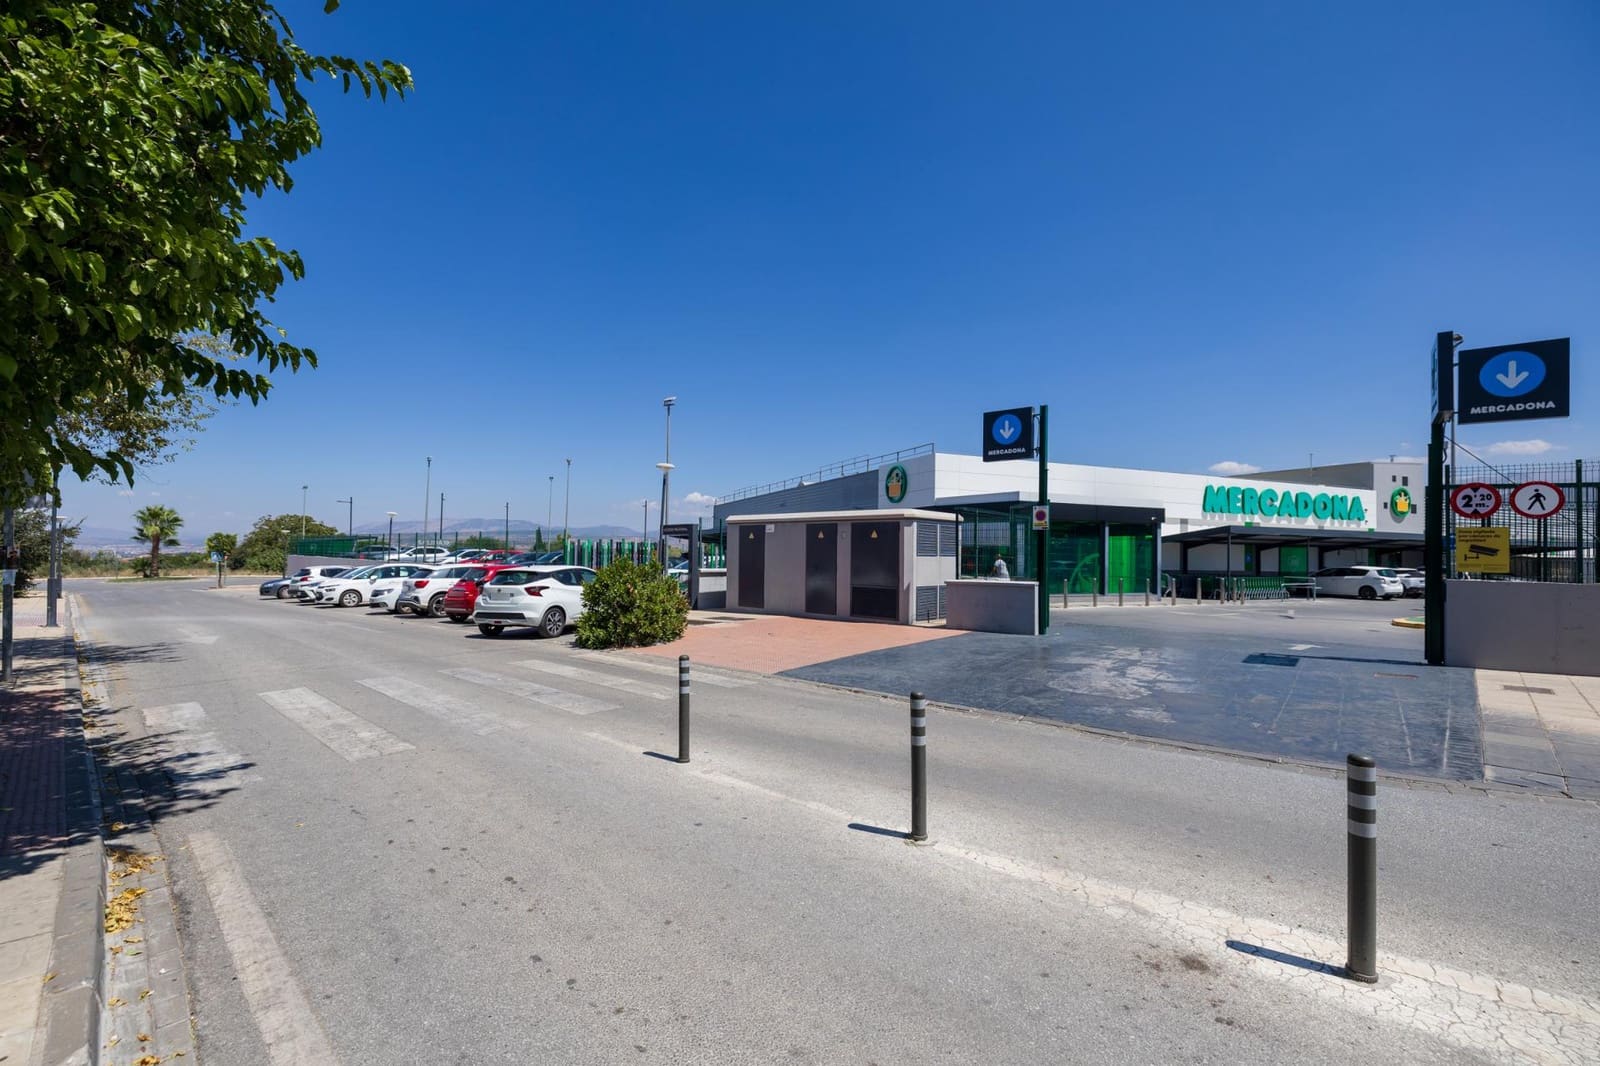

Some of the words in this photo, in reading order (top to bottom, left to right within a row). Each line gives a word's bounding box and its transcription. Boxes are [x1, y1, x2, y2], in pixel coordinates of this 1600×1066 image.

[1470, 400, 1556, 414] MERCADONA
[988, 447, 1026, 456] MERCADONA
[1203, 485, 1365, 521] MERCADONA
